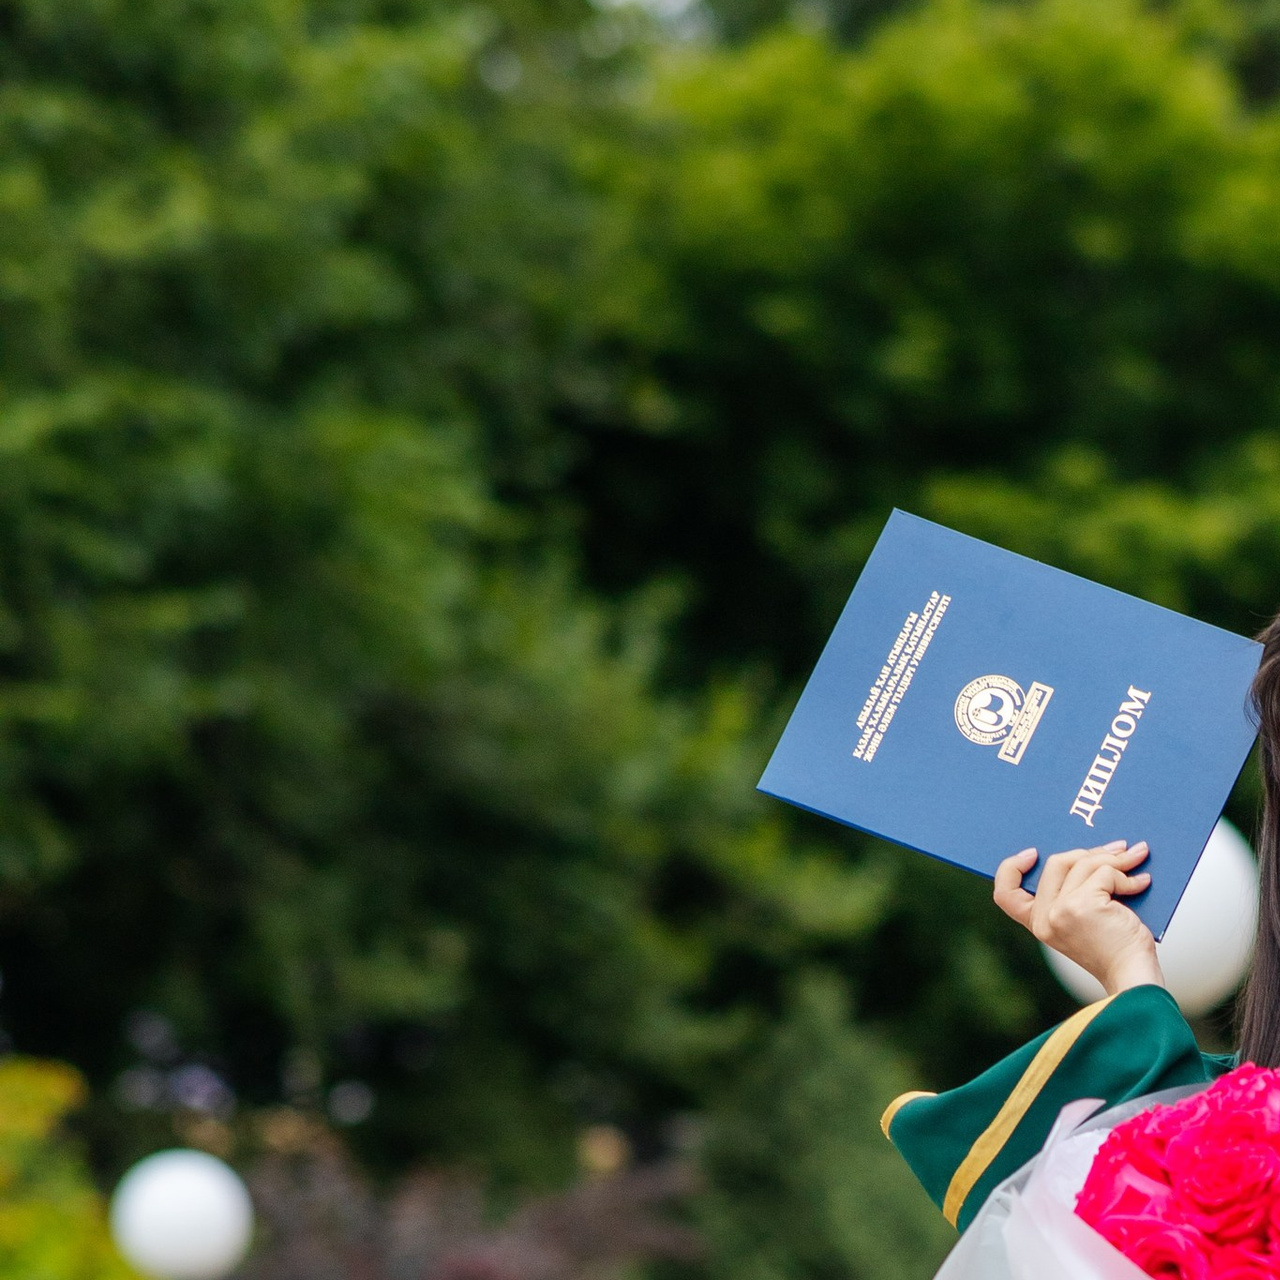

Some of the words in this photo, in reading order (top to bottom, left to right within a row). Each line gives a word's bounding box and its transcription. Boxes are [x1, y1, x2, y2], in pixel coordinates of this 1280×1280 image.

[856, 686, 881, 729] АБЫЛАЙ
[875, 665, 891, 688] ХАН
[1070, 685, 1151, 827] ДИПЛОМ
